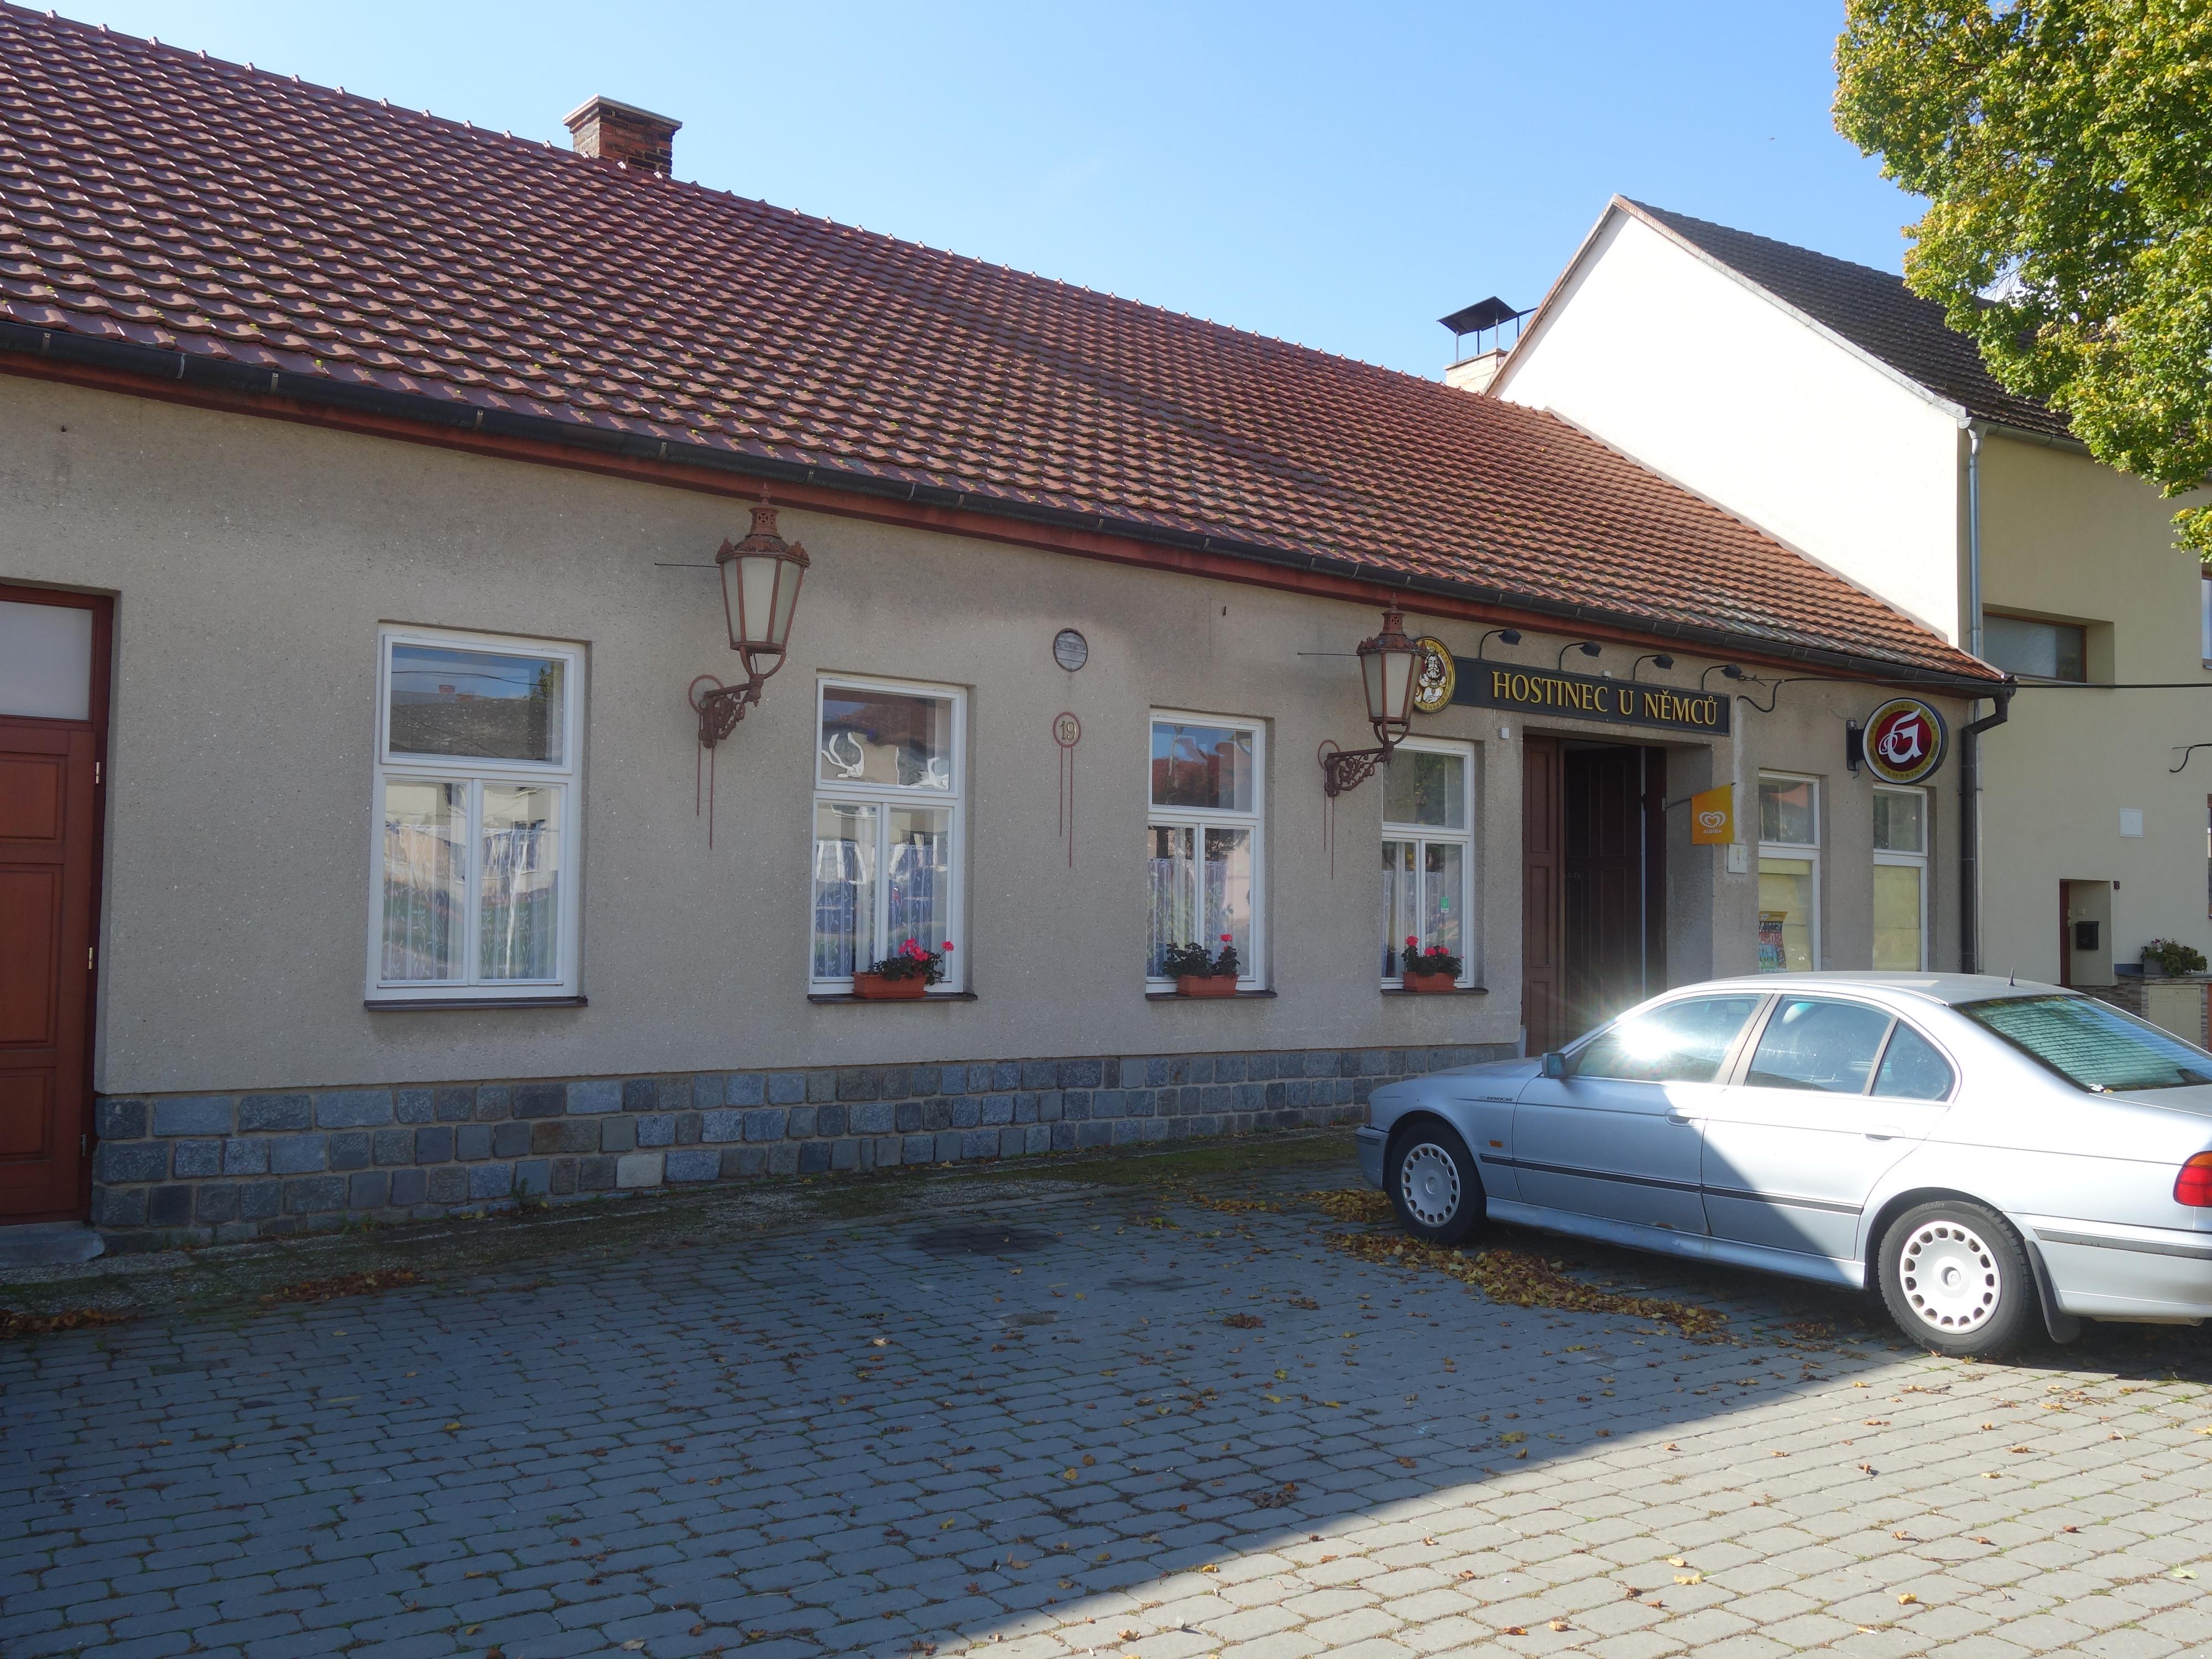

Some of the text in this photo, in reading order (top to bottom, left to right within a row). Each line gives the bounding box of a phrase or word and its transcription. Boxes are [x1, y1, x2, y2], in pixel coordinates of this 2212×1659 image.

[1492, 671, 1718, 725] HOSTINEC U NĚMCŮ
[1889, 703, 1912, 712] ROKU
[1060, 721, 1077, 740] 19
[1880, 762, 1930, 779] GAMBRINUS
[2113, 880, 2120, 890] 18
